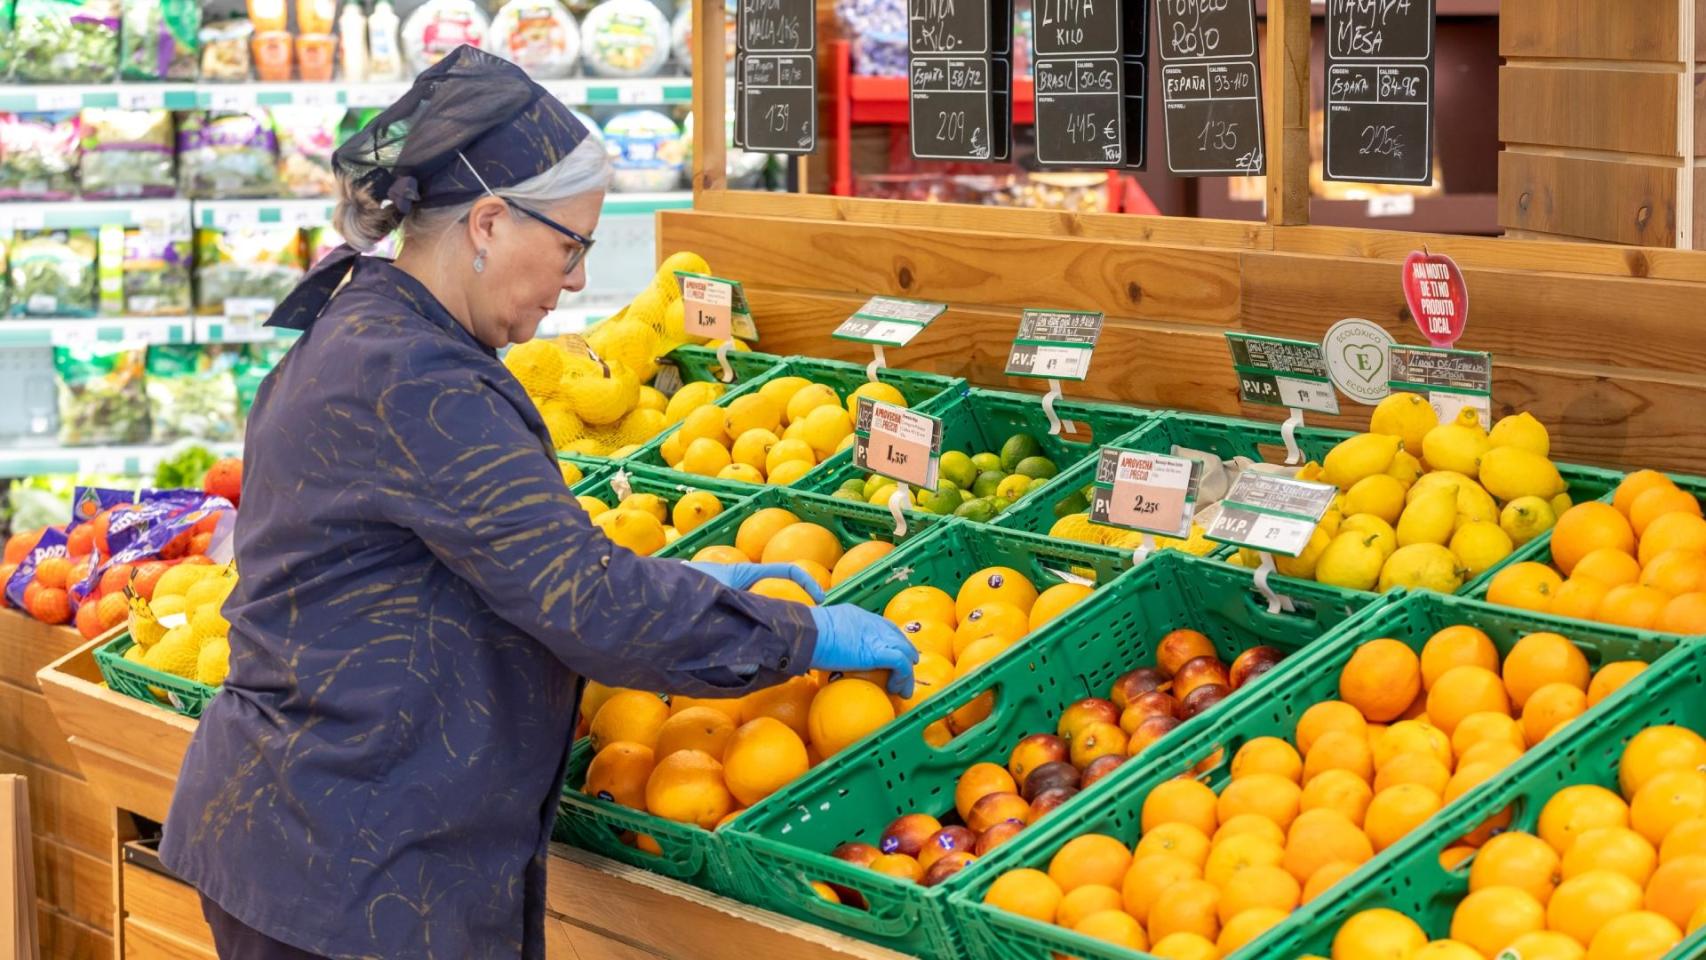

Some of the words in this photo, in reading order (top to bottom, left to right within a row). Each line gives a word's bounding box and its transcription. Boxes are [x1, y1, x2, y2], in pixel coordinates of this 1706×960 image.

[1057, 28, 1084, 45] KILO
[1338, 21, 1383, 55] MESA
[951, 67, 984, 89] 58/72
[1038, 71, 1073, 91] BRASIL
[1167, 75, 1206, 93] ESPAÑA
[1214, 73, 1249, 92] 93-110
[1381, 75, 1420, 97] 84-96
[1425, 263, 1450, 280] MOITO
[1438, 281, 1450, 298] NO
[1421, 298, 1455, 316] PRODUTO
[1356, 353, 1372, 371] E
[1242, 379, 1277, 396] P.V.P.
[1120, 457, 1153, 471] APROVECHA
[1129, 469, 1149, 481] PRECIO
[1133, 494, 1161, 514] 2,25€
[1216, 516, 1248, 535] P.V.P.
